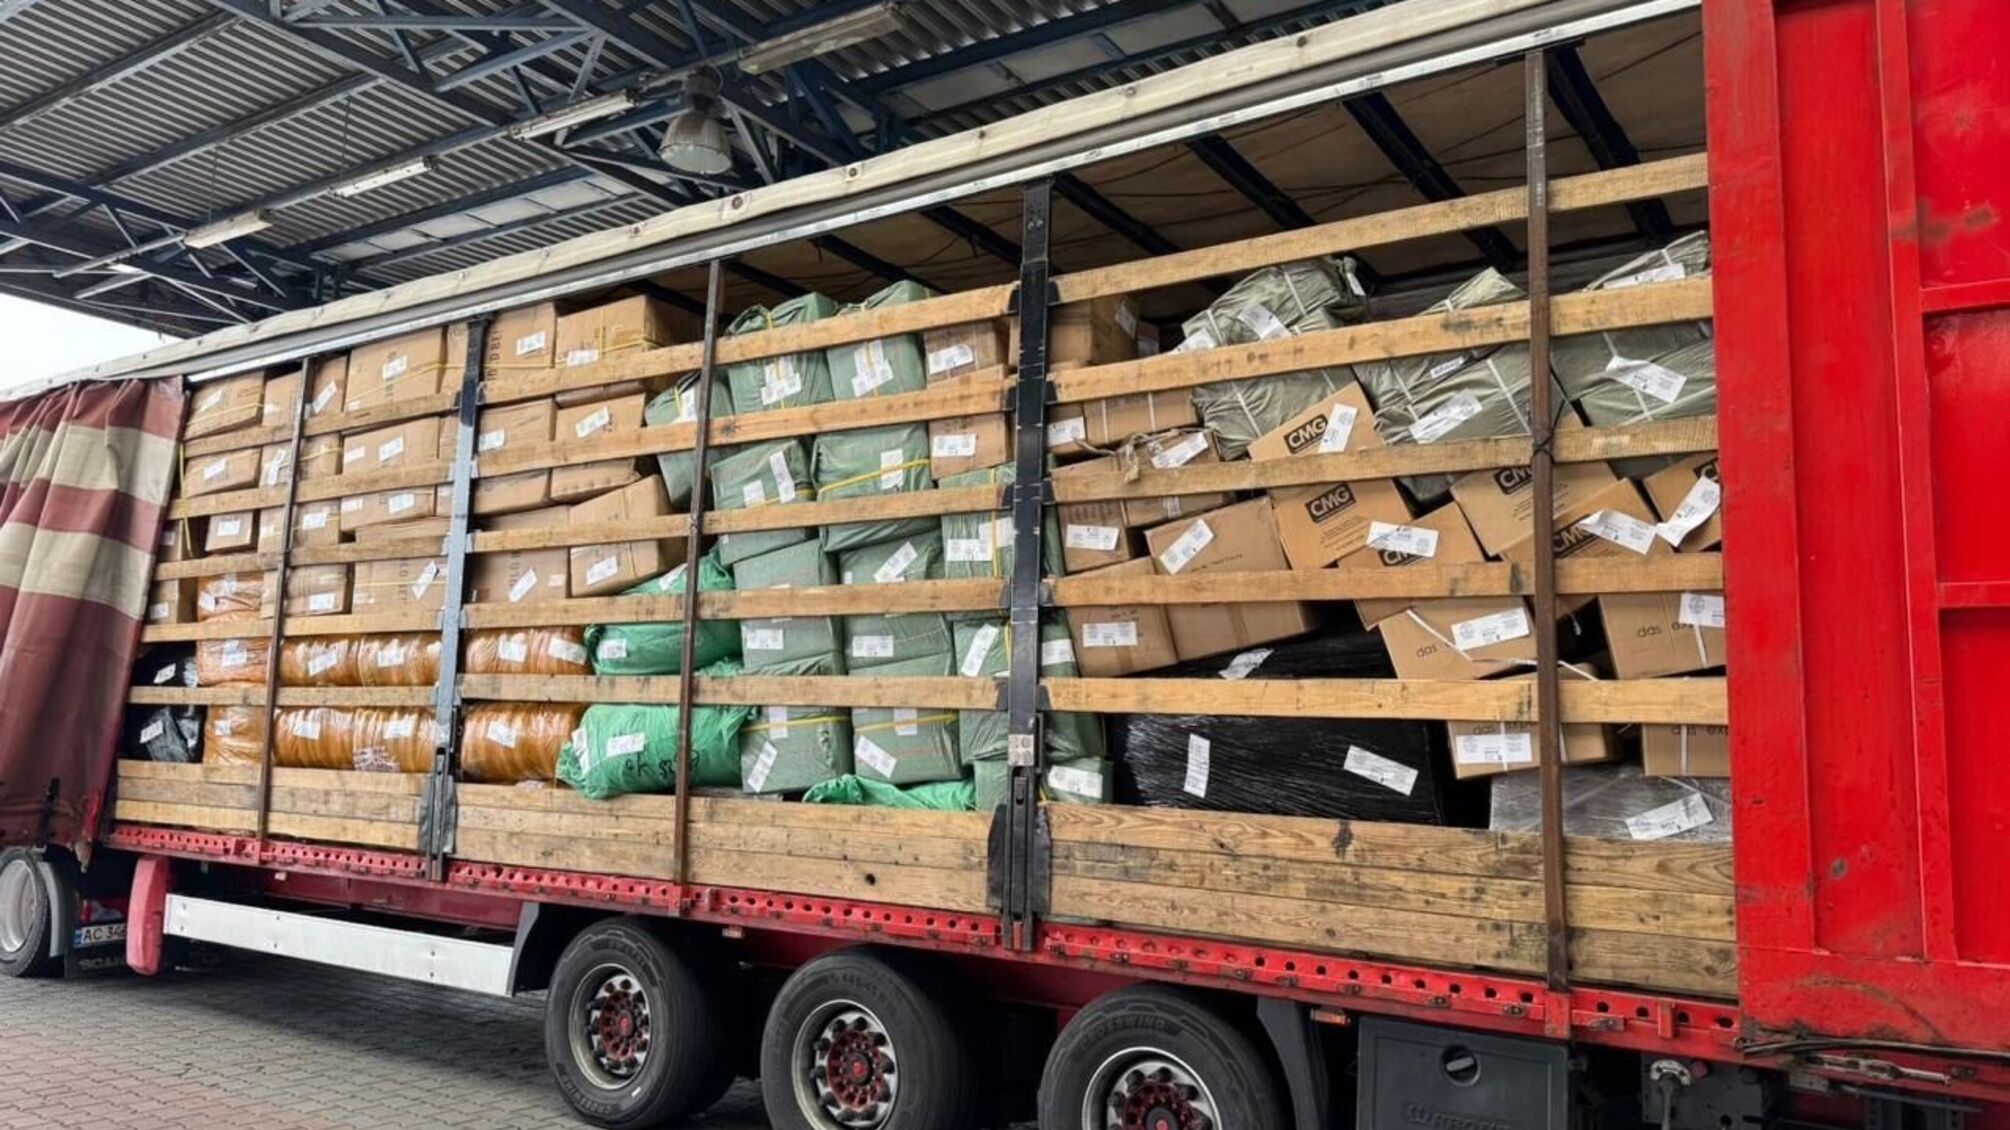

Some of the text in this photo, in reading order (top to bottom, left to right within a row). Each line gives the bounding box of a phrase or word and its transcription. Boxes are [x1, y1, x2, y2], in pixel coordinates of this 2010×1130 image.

[1288, 417, 1327, 448] CMG
[1310, 486, 1351, 517] CMG
[1637, 624, 1662, 638] das
[1415, 644, 1438, 658] das
